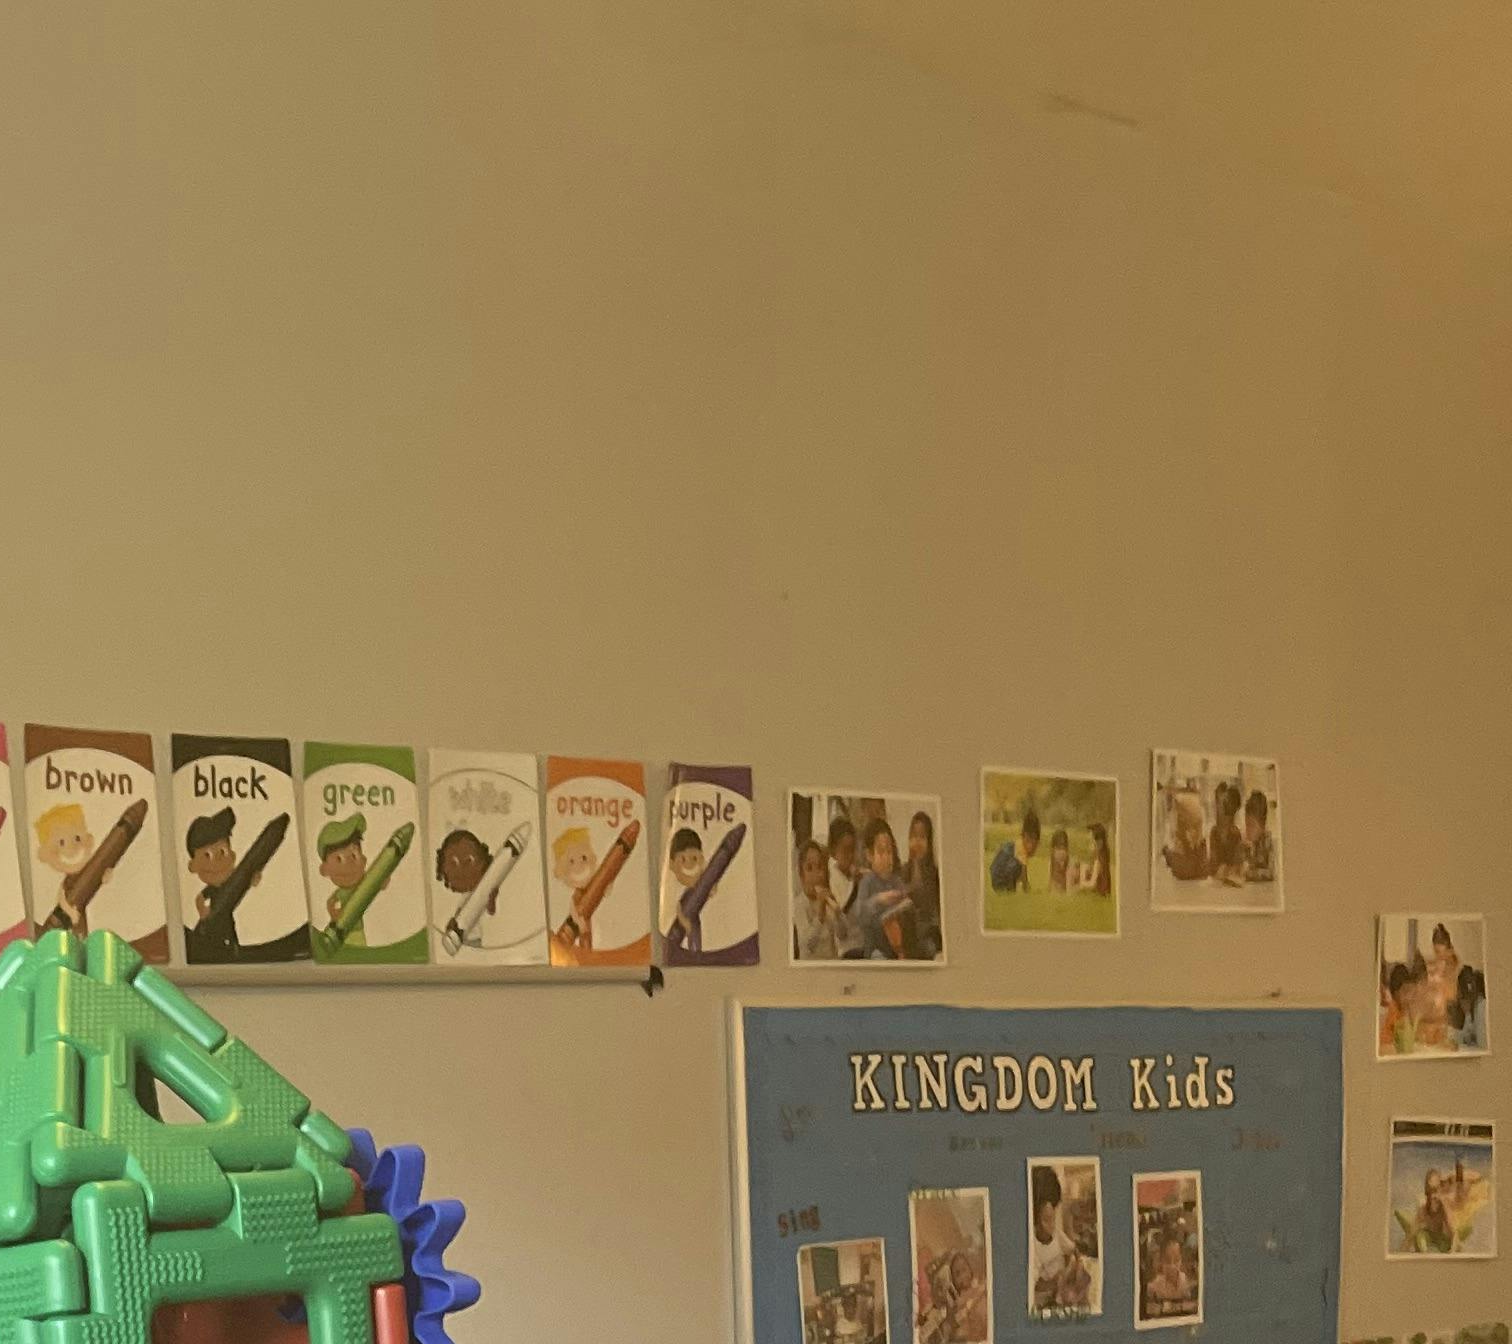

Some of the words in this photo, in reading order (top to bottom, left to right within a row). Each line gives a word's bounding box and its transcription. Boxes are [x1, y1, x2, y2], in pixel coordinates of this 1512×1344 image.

[45, 757, 134, 797] brown
[193, 765, 270, 802] black
[322, 781, 396, 817] green
[557, 793, 634, 827] orange
[849, 1052, 1099, 1114] KINGDOM
[1130, 1056, 1237, 1112] Kids
